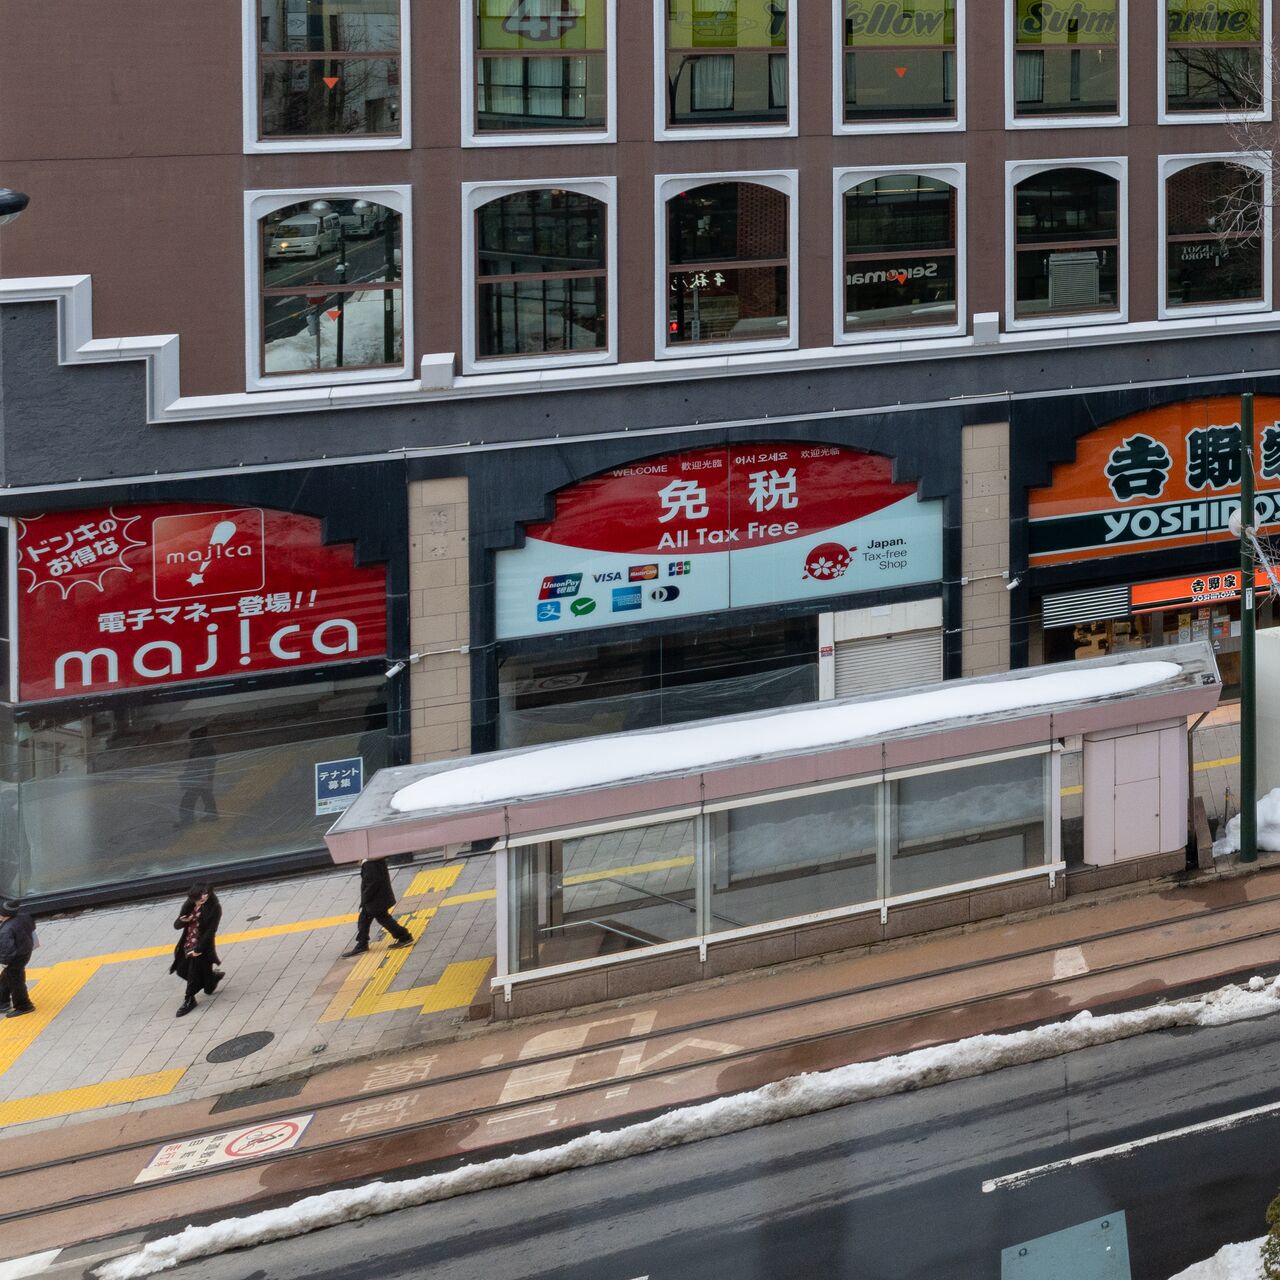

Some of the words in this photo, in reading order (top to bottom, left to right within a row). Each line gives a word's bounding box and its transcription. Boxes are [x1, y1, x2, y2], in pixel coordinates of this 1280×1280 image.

[735, 454, 755, 466] 어서
[758, 451, 788, 463] 오세요
[613, 464, 668, 477] WELCOME
[657, 467, 799, 524] 免税
[26, 518, 118, 563] ドンキの
[657, 529, 688, 550] All
[696, 526, 740, 546] Tax
[748, 521, 800, 540] Free
[47, 536, 120, 577] お得な
[863, 549, 907, 561] Tax-free
[879, 559, 907, 570] Shop
[592, 571, 622, 583] VISA
[668, 562, 692, 576] JCB
[542, 578, 580, 590] UnionPay
[319, 767, 359, 781] テナント
[328, 778, 351, 790] 募集
